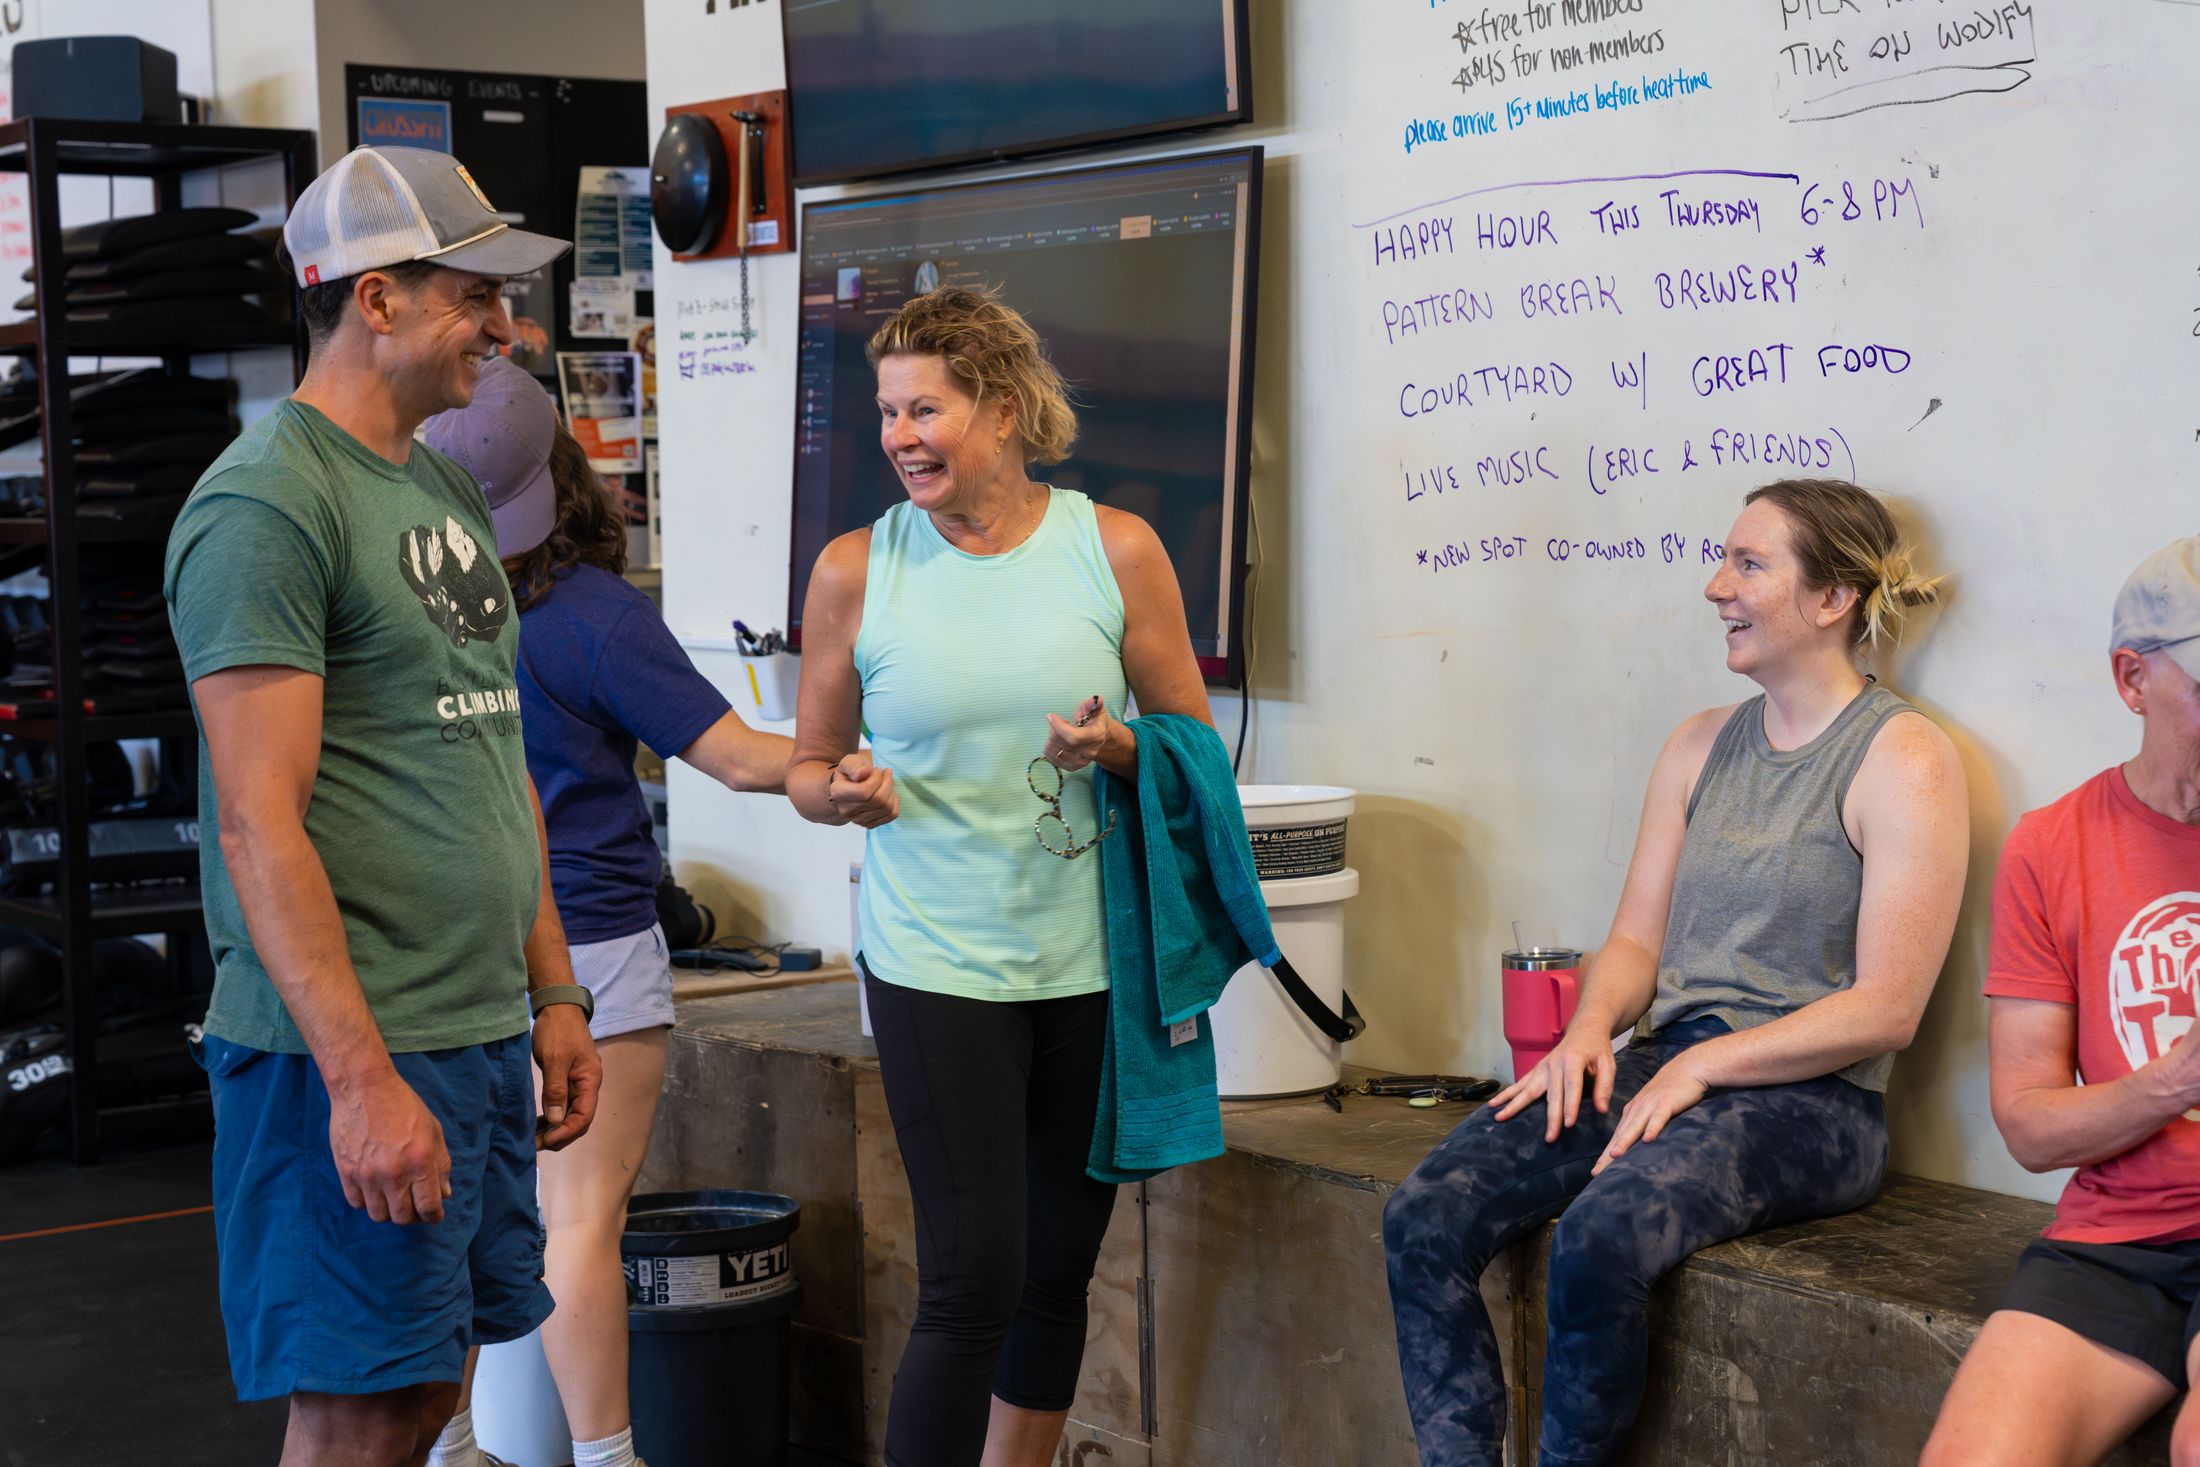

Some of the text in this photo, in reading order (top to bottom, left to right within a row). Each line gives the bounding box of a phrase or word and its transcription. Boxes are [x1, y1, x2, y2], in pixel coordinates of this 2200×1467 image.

[1475, 8, 1522, 44] free
[1523, 0, 1556, 33] for
[1780, 0, 2038, 79] TIME ON WODIFY
[1511, 44, 1543, 77] for
[1550, 29, 1664, 73] non-members
[371, 74, 522, 99] UPCOMING EVENTS
[1405, 118, 1447, 154] please
[1452, 111, 1498, 138] arrive
[1506, 96, 1532, 130] 15+
[1595, 80, 1640, 111] before
[1374, 177, 1925, 266] HAPPY HOUR THIS THURSDAY 6-8 PM
[1383, 288, 1493, 345] PATTERN
[1520, 275, 1623, 319] BREAK
[1400, 342, 1912, 418] COURTYARD W/ GREAT FOOD
[1405, 427, 1856, 501] LIVE MUSIC (ERIC & FRIENDS)
[1480, 536, 1528, 562] SPOT
[1546, 536, 1646, 562] CO-OWNED
[1660, 532, 1686, 564] BY
[1701, 538, 1725, 565] RO
[33, 832, 60, 853] 10
[174, 823, 199, 843] 10
[7, 1062, 46, 1092] 30
[727, 1240, 789, 1283] YETI
